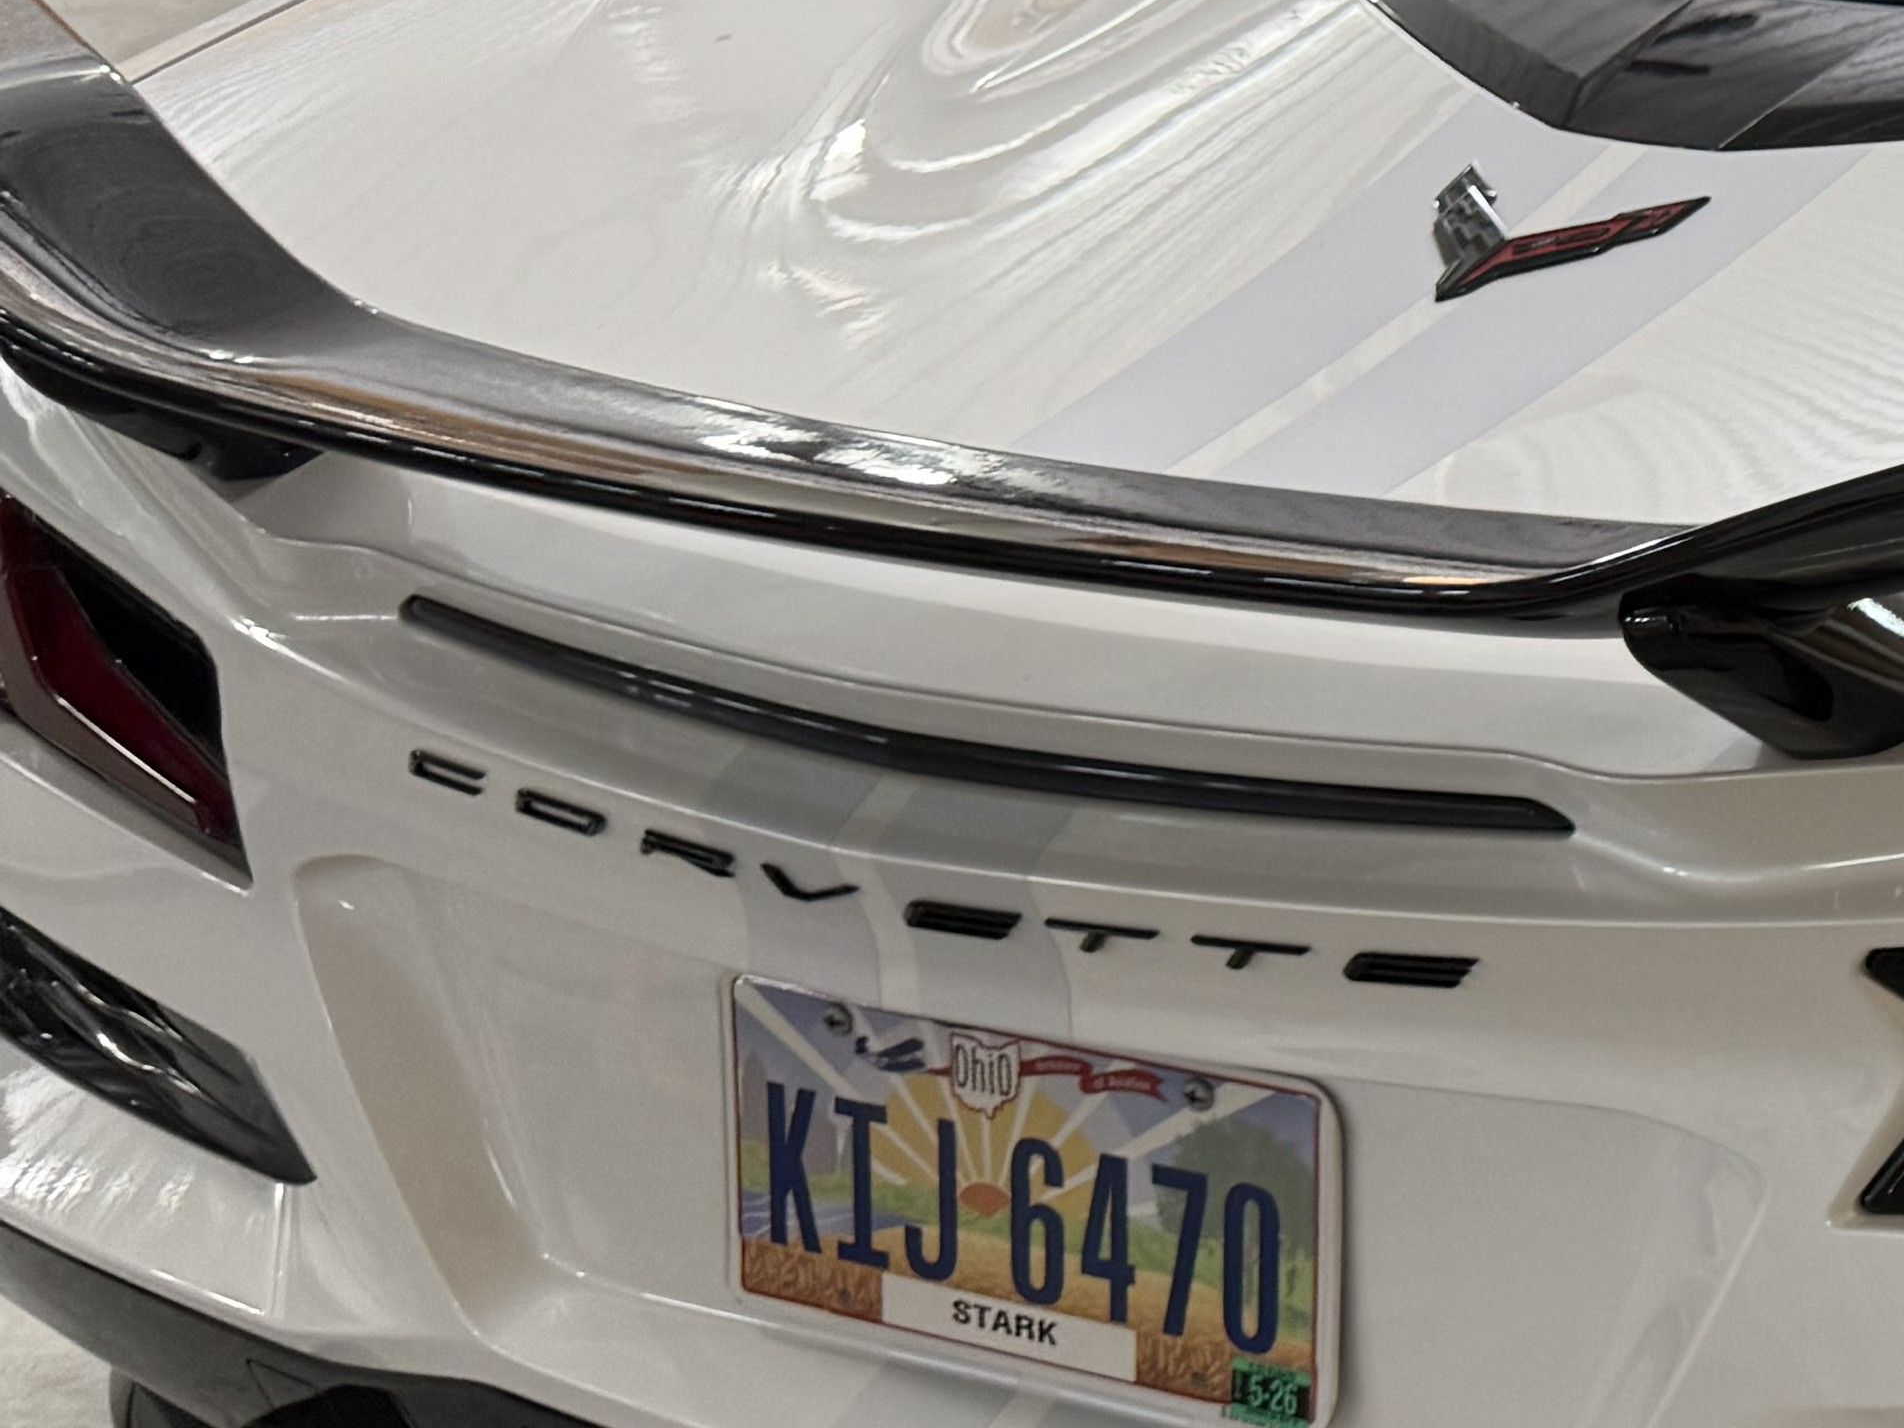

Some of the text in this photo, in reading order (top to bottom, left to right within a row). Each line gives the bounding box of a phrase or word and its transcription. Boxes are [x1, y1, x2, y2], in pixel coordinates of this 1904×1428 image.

[408, 748, 1481, 988] CORVETTE
[954, 1043, 1013, 1097] Ohio
[766, 1081, 1281, 1355] KIJ 6470
[952, 1299, 1059, 1347] STARK
